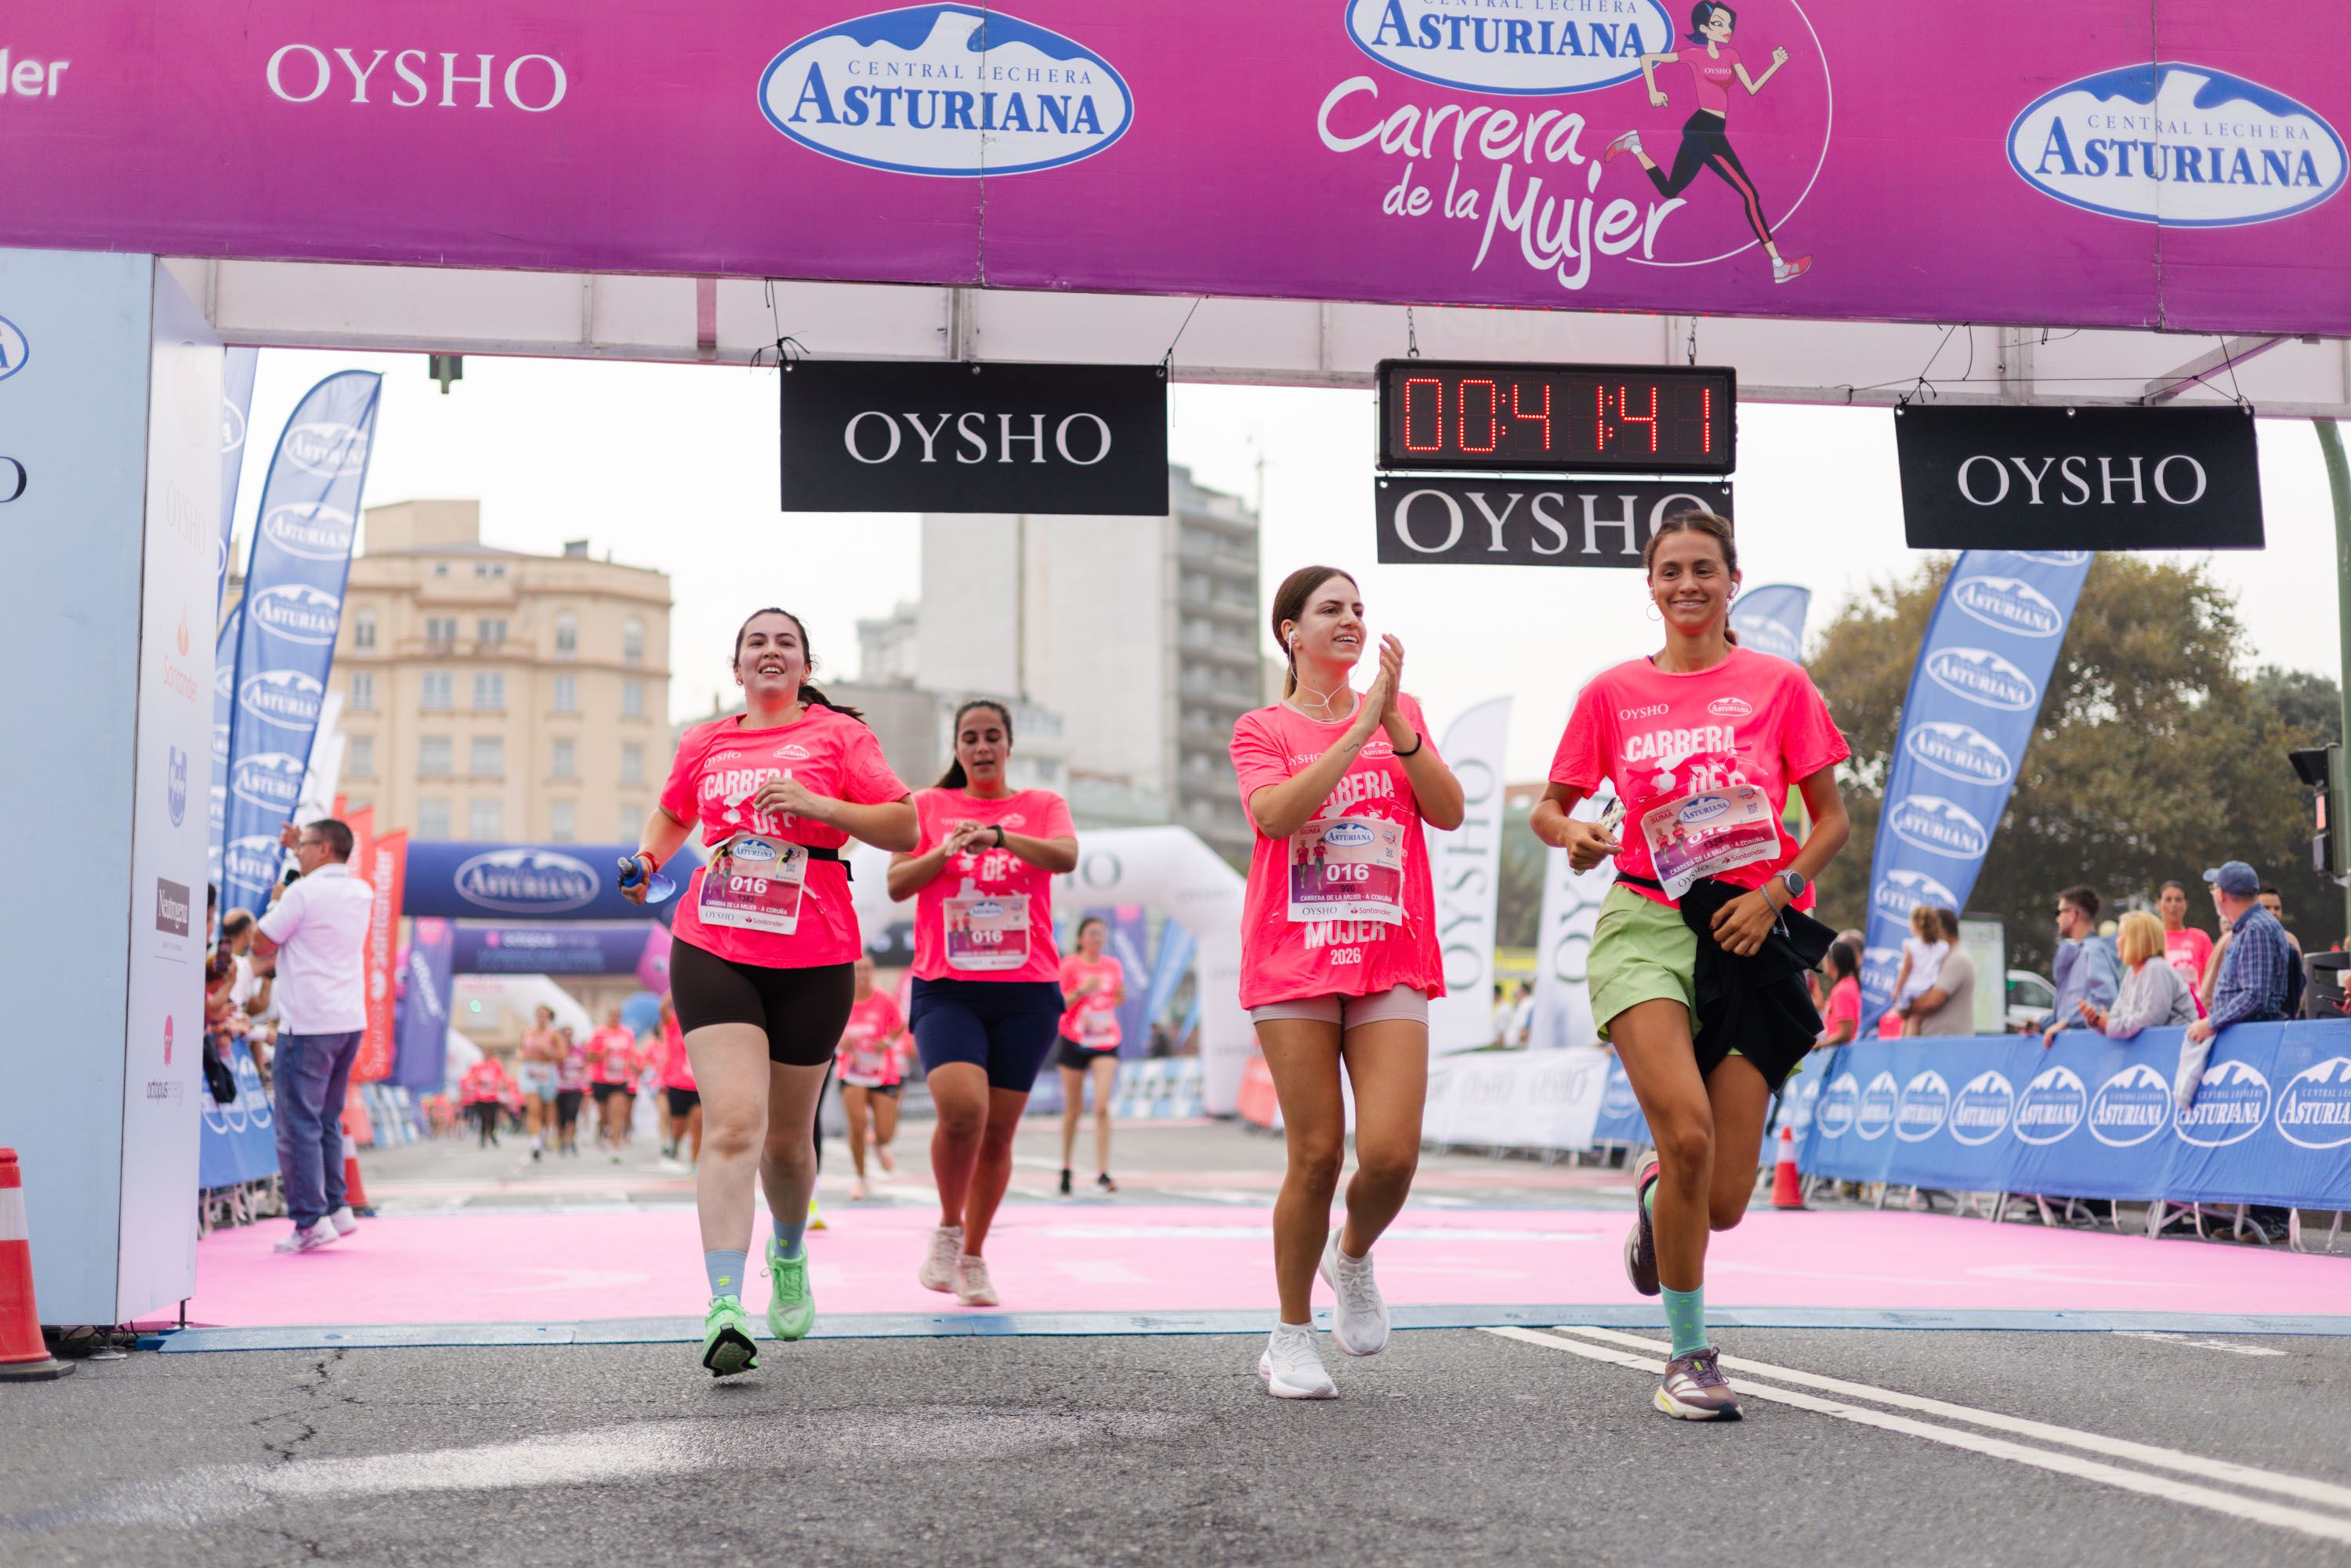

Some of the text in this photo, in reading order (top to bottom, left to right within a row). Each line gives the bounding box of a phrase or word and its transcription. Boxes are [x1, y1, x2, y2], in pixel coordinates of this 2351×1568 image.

[1422, 0, 1637, 13] NTRAL LECHERA
[1371, 0, 1647, 59] ASTURIANA
[266, 44, 567, 112] OYSHO
[849, 60, 1092, 85] CENTRAL LECHERA
[1704, 67, 1732, 76] OYSHO
[788, 60, 1105, 135] ASTURIANA
[1317, 76, 1586, 165] Carrera
[2088, 114, 2310, 140] CENTRAL LECHERA
[2034, 115, 2323, 187] ASTURIANA
[1383, 159, 1688, 291] de la Mujer
[1405, 378, 1711, 454] 00:41:41
[844, 411, 1111, 465] OYSHO
[1958, 454, 2207, 506] OYSHO
[1961, 584, 2052, 633] ASTURIANA
[1935, 655, 2026, 705] ASTURIANA
[1620, 704, 1668, 720] OYSHO
[1712, 703, 1750, 713] ASTURIANA
[1626, 726, 1737, 762] CARRERA
[704, 751, 742, 767] OYSHO
[1915, 732, 2003, 780] ASTURIANA
[1650, 811, 1673, 824] SUMA
[1683, 802, 1728, 820] ASTURIANA
[1328, 831, 1371, 842] ASTURIANA
[735, 846, 773, 859] ASTURIANA
[1669, 860, 1694, 875] CARRERA
[1712, 845, 1731, 856] MUJER
[1730, 848, 1767, 861] Santander
[1326, 864, 1370, 882] 016
[730, 875, 769, 895] 016
[1340, 884, 1355, 893] 990
[1371, 894, 1393, 903] CORUÑA
[705, 911, 734, 922] OYSHO
[1302, 906, 1338, 915] OYSHO
[1359, 907, 1392, 916] Santander
[752, 917, 784, 928] Santander
[972, 929, 1003, 944] 016
[1304, 921, 1386, 950] MUJER
[1330, 947, 1362, 965] 2026
[2092, 1094, 2163, 1125] ASTURIANA
